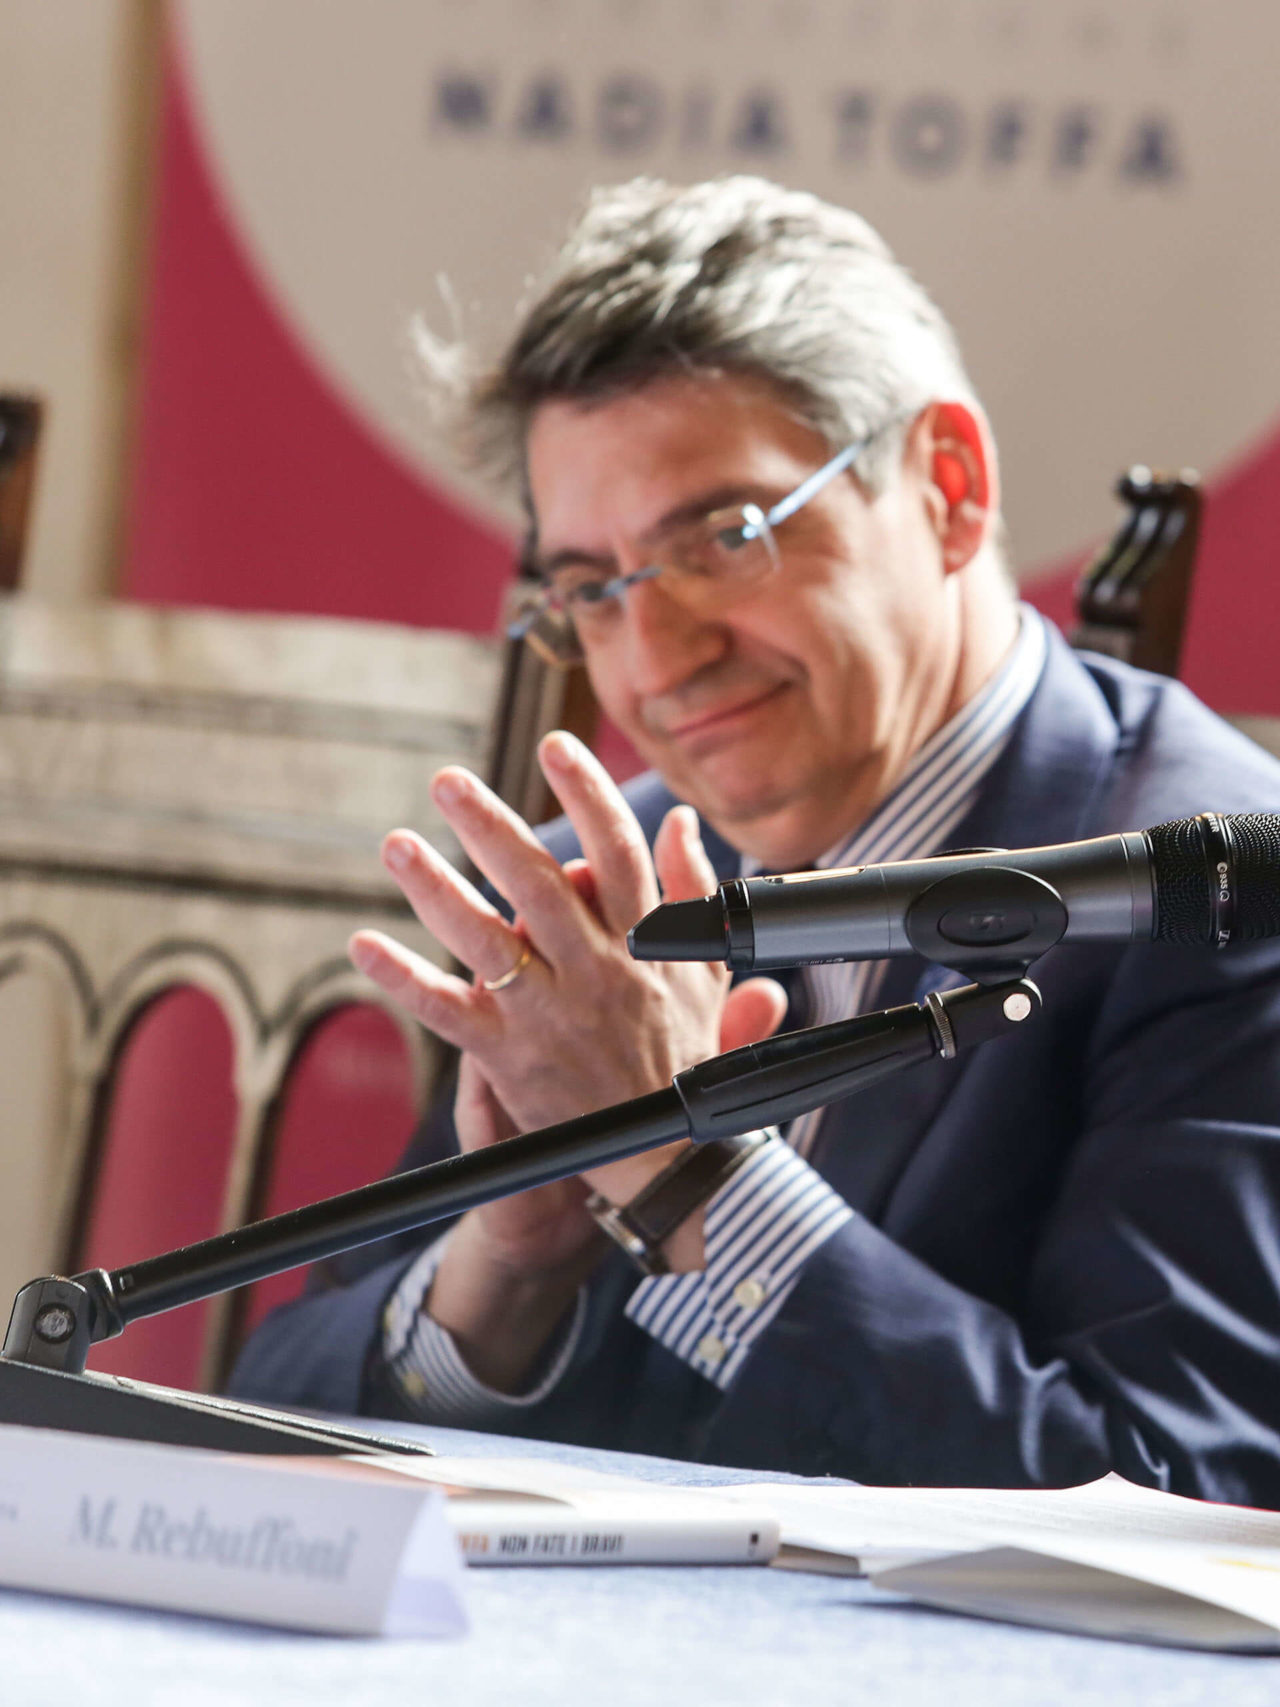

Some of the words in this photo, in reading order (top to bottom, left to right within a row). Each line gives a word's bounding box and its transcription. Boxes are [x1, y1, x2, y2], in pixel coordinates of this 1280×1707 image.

[432, 65, 786, 158] NADIA
[832, 86, 1182, 186] TOFFA
[499, 1533, 528, 1553] NON
[533, 1533, 567, 1554] FATE
[581, 1533, 625, 1554] BRAVI
